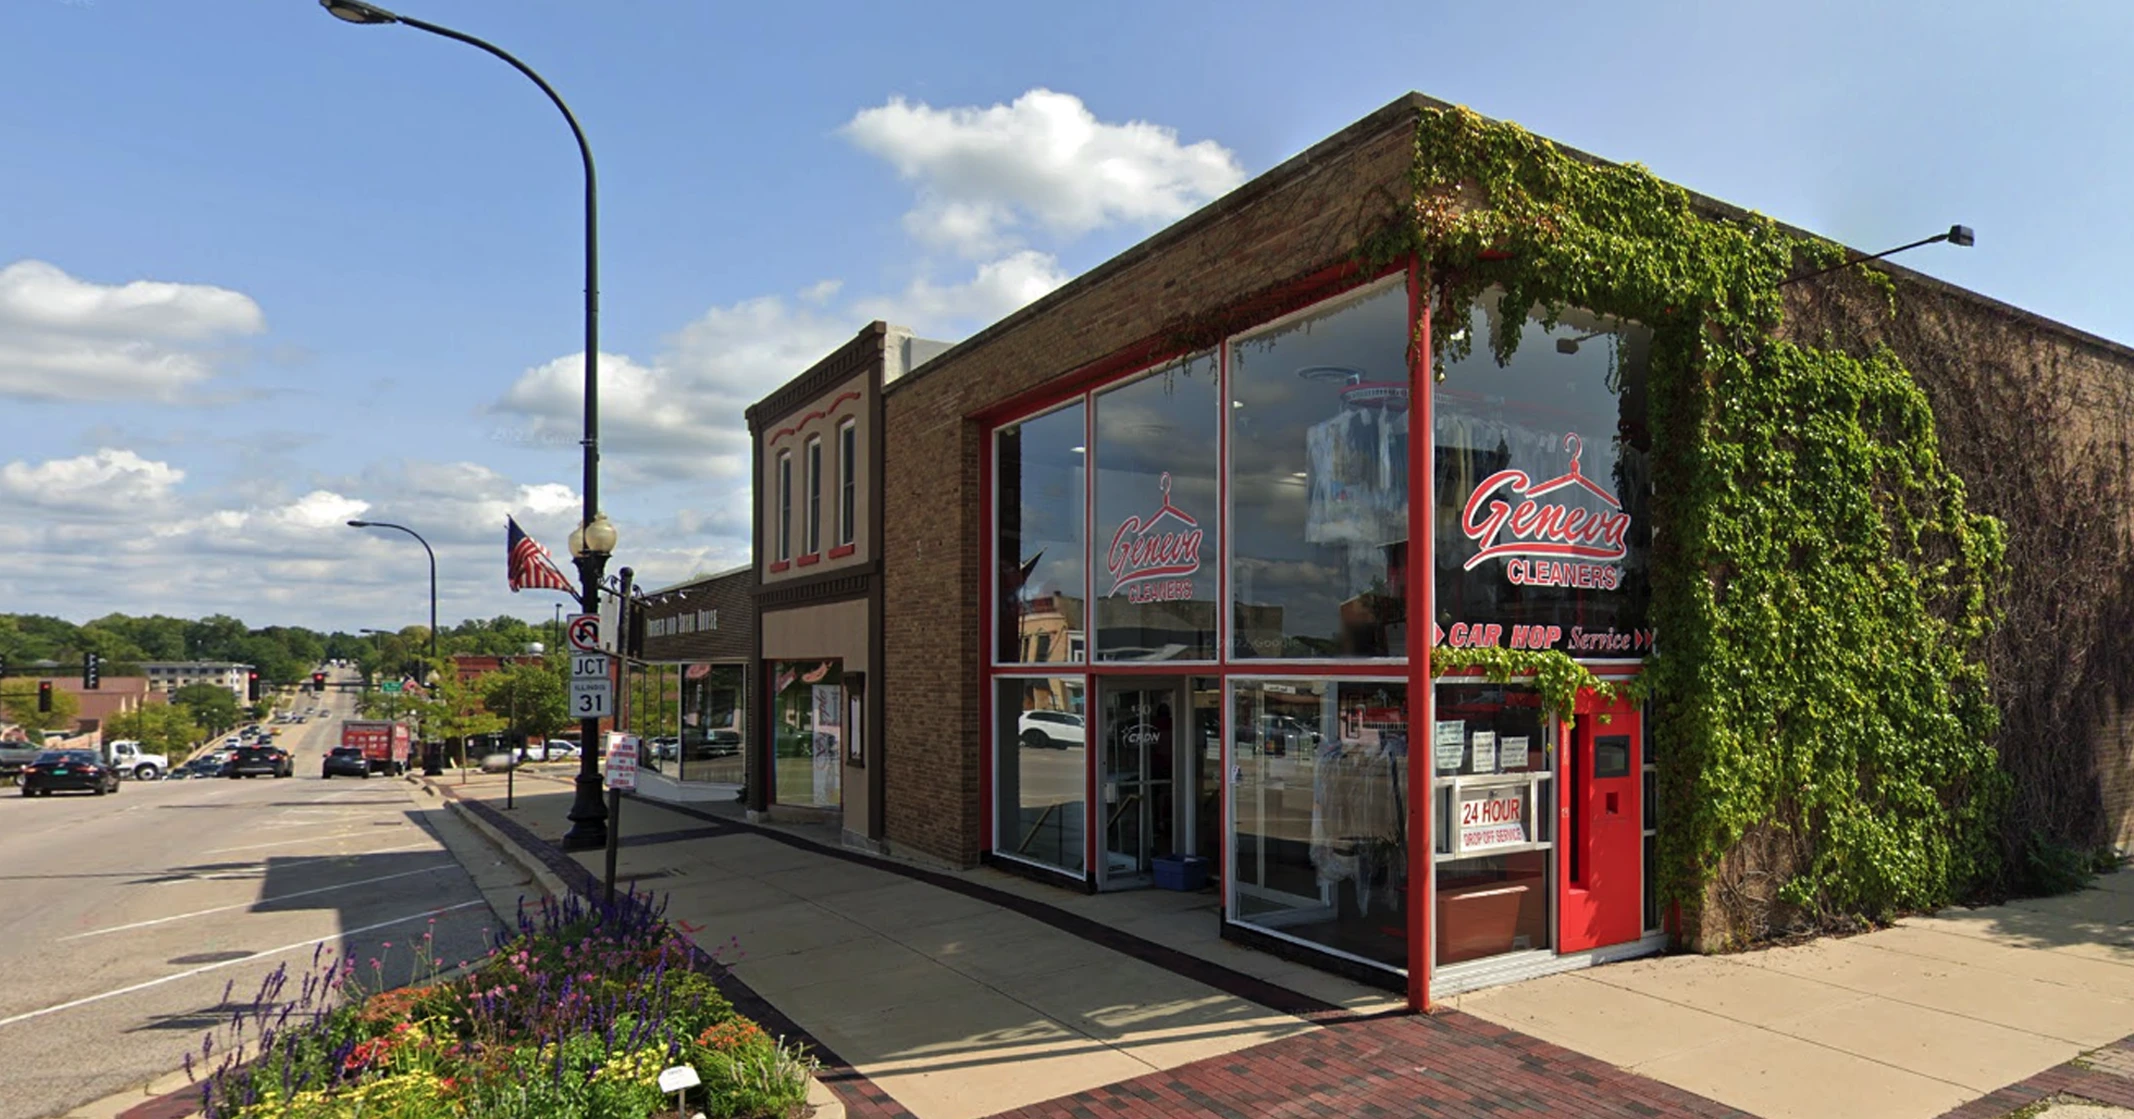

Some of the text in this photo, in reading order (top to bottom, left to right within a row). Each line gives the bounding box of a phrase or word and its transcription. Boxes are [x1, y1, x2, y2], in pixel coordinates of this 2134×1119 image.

[1462, 469, 1632, 551] Geneva
[1108, 515, 1203, 579] Geneva
[1507, 558, 1618, 590] CLEANERS
[1129, 579, 1192, 604] CLEANERS
[1449, 622, 1631, 651] CAR HOP Service
[574, 658, 605, 676] JCT
[574, 683, 606, 691] ILLINOIS
[579, 694, 602, 712] 31
[1463, 797, 1520, 825] 24 HOUR
[1463, 827, 1522, 847] DROP OFF SERVICE
